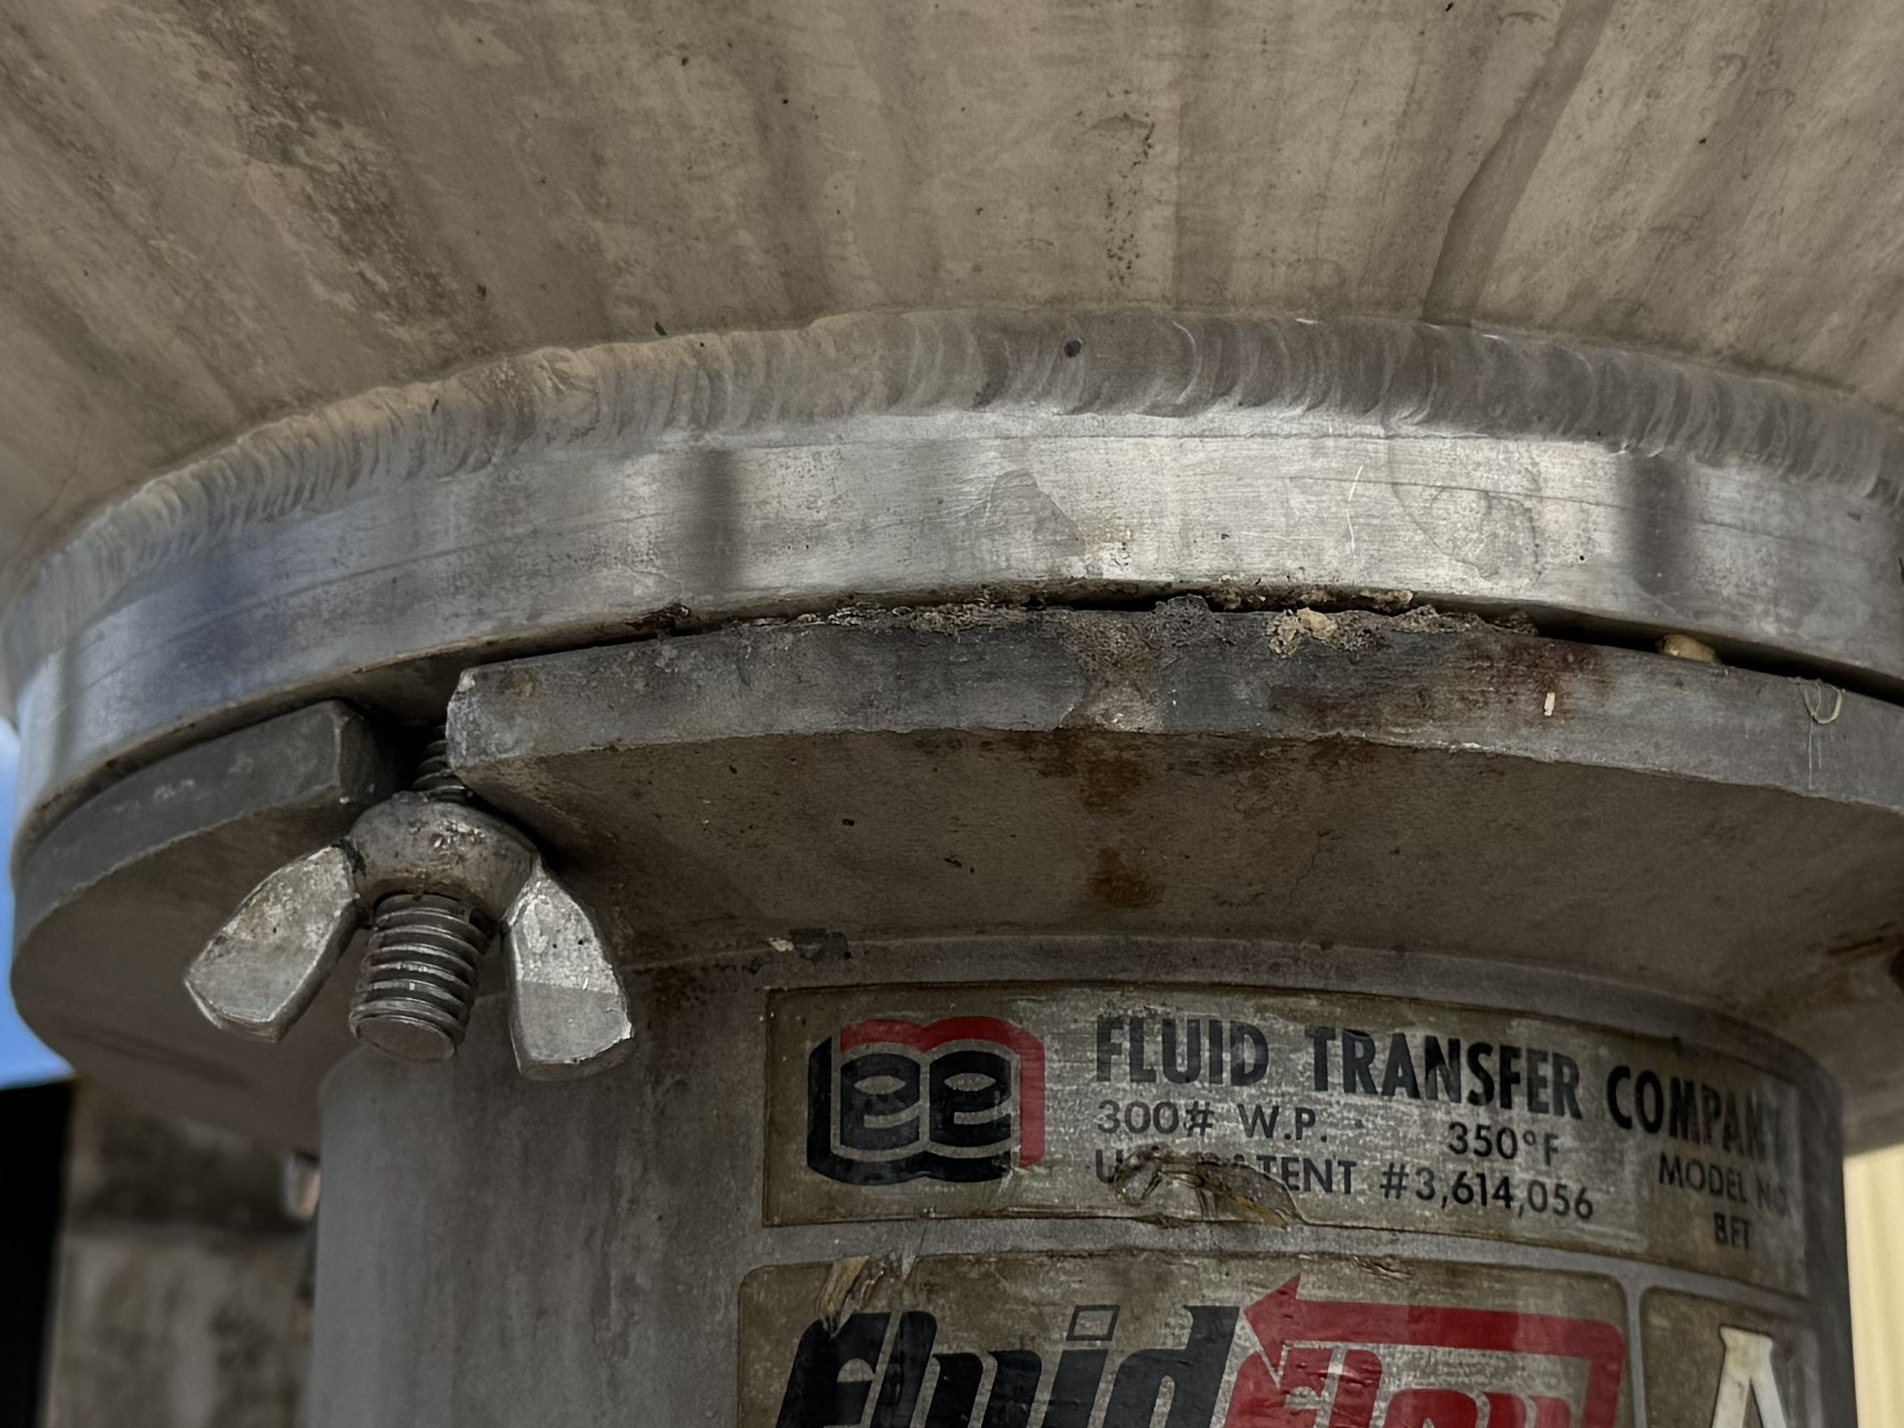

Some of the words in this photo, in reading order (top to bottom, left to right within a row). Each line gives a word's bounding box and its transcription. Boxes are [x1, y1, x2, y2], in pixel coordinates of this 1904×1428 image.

[1096, 1017, 1269, 1086] FLUID
[1305, 1025, 1582, 1120] TRANSFER
[1097, 1099, 1215, 1138] 300#
[1237, 1103, 1328, 1143] W.P.
[1448, 1121, 1559, 1167] 350°F
[1380, 1161, 1594, 1221] #3,614,056
[1659, 1151, 1748, 1204] MODEL
[1713, 1212, 1750, 1251] BFT
